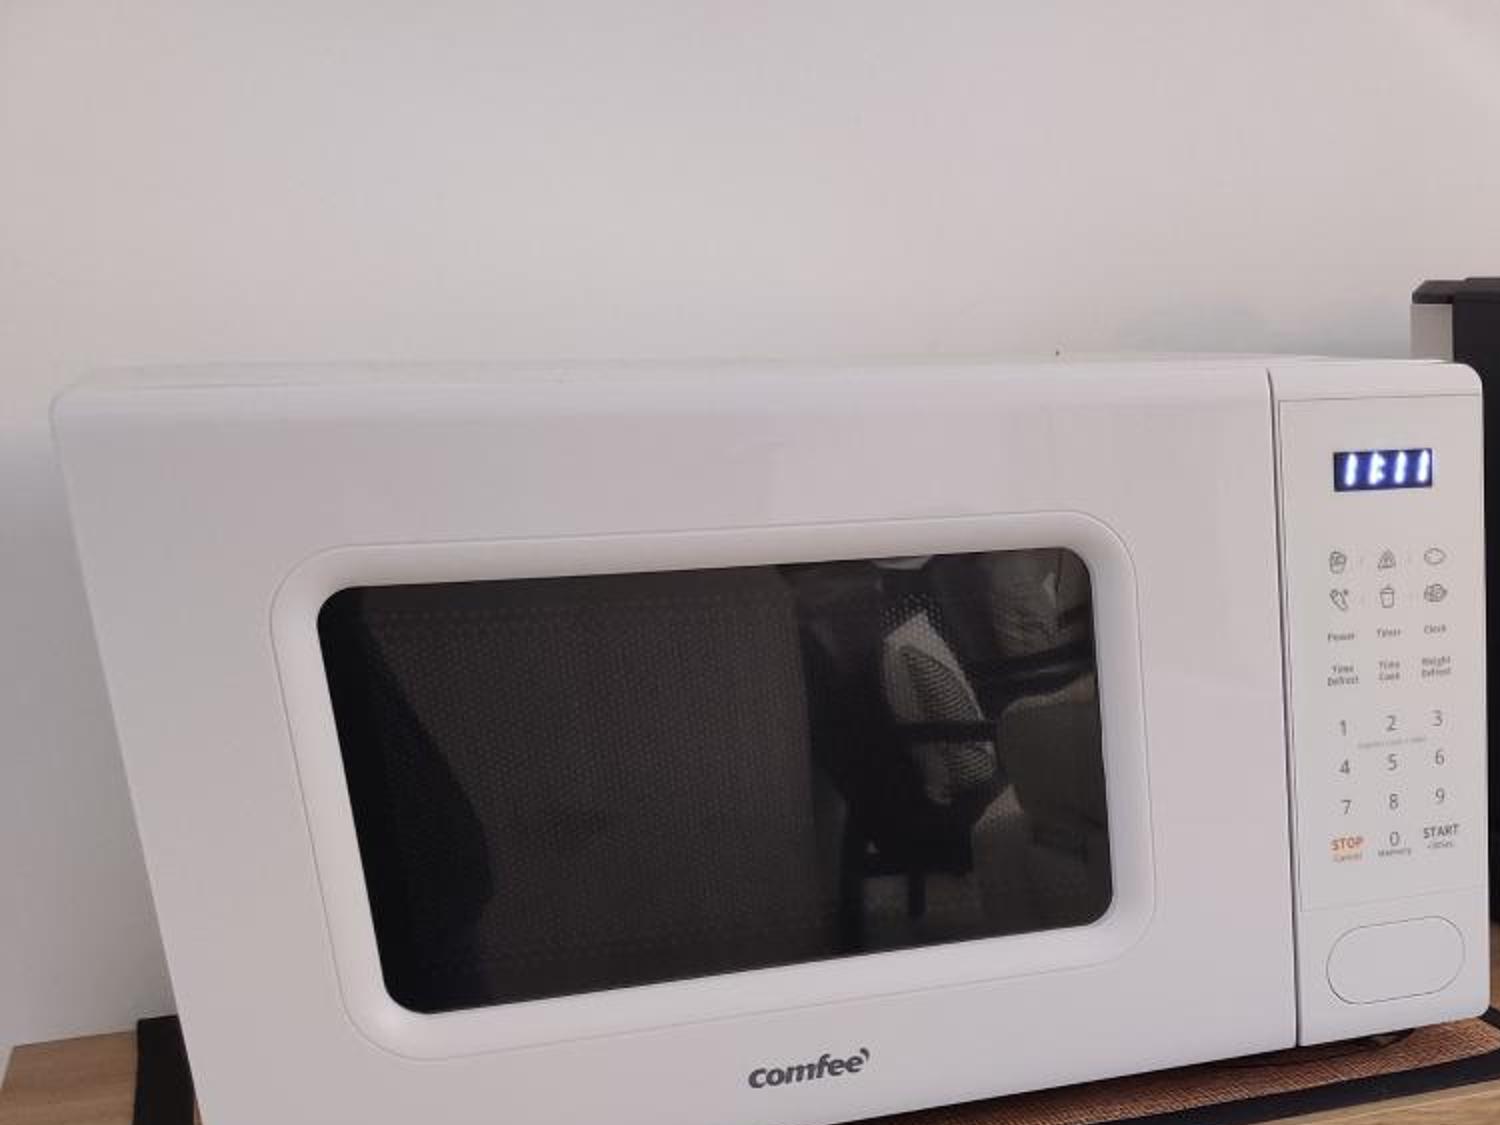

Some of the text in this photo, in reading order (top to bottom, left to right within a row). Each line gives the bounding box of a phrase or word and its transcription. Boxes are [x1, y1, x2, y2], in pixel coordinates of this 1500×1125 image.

[1386, 714, 1398, 732] 2
[1432, 709, 1443, 727] 3
[1340, 719, 1347, 736] 1
[1339, 758, 1350, 774] 4
[1387, 752, 1397, 771] 5
[1435, 749, 1445, 766] 6
[1389, 793, 1399, 810] 8
[1435, 787, 1445, 804] 9
[1341, 799, 1352, 815] 7
[1388, 831, 1400, 847] 0
[1423, 823, 1460, 839] START
[1330, 836, 1364, 851] STOP
